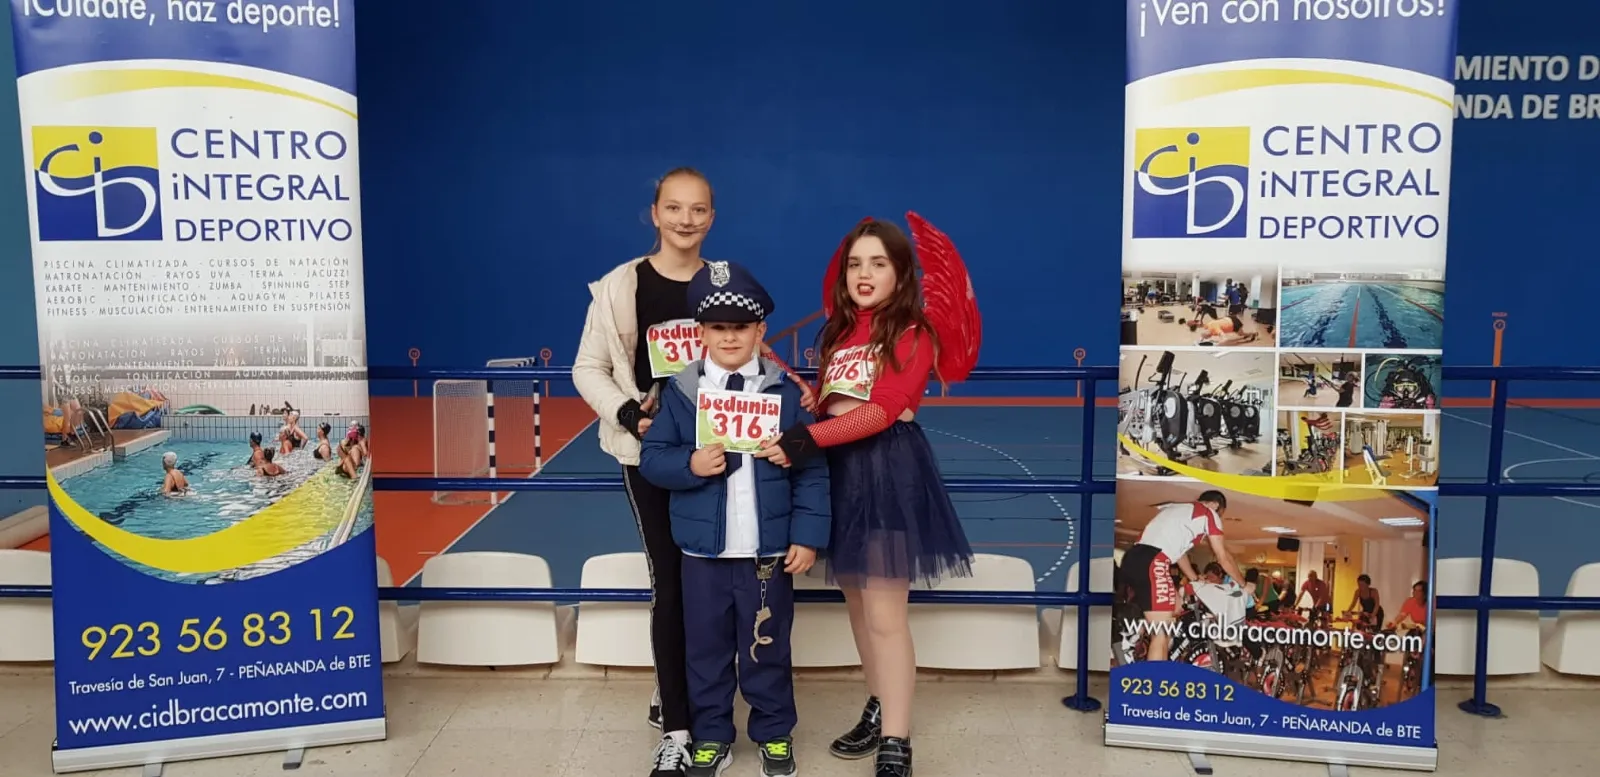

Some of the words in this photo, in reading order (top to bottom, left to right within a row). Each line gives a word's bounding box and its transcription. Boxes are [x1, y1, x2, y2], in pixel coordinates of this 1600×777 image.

[167, 0, 217, 22] haz
[226, 0, 340, 32] deporte!
[1140, 0, 1208, 37] ¡Ven
[1221, 0, 1279, 24] con
[1293, 0, 1445, 21] nosotros!
[1454, 55, 1570, 81] MIENTO
[1453, 94, 1514, 119] NDA
[1521, 94, 1560, 119] DE
[171, 128, 347, 160] CENTRO
[1263, 122, 1441, 156] CENTRO
[175, 219, 352, 241] DEPORTIVO
[1260, 214, 1439, 239] DEPORTIVO
[43, 260, 94, 269] PISCINA
[105, 259, 188, 268] CLIMATIZADA
[209, 258, 255, 267] CURSOS
[265, 258, 279, 267] DE
[289, 256, 349, 267] NATACIÓN
[45, 270, 142, 281] MATRONATACIÓN
[166, 271, 200, 280] RAYOS
[210, 270, 231, 279] UVA
[250, 269, 284, 278] TERMA
[306, 269, 349, 278] JACUZZI
[45, 284, 83, 293] KARATE
[103, 282, 189, 292] MANTENIMIENTO
[209, 281, 242, 290] ZUMBA
[262, 280, 310, 290] SPINNING
[329, 279, 350, 289] STEP
[46, 295, 96, 305] AEROBIC
[121, 292, 207, 304] TONIFICACIÓN
[231, 292, 286, 301] AQUAGYM
[309, 291, 350, 300] PILATES
[47, 307, 87, 317] FITNESS
[99, 304, 173, 316] MUSCULACIÓN
[184, 304, 268, 314] ENTRENAMIENTO
[273, 304, 285, 312] EN
[291, 301, 351, 312] SUSPENSIÓN
[170, 348, 204, 357] RAYOS
[699, 394, 779, 416] bedunia
[713, 413, 762, 439] 316
[1153, 559, 1169, 604] JOARA
[81, 621, 161, 661] 923
[177, 616, 228, 653] 56
[242, 611, 292, 647] 83
[310, 606, 355, 641] 12
[1124, 613, 1422, 653] www.cidbracamonte.com
[69, 677, 124, 695] Travesía
[128, 674, 145, 690] de
[149, 672, 174, 688] San
[177, 668, 212, 686] Juan,
[216, 667, 225, 682] 7
[238, 659, 326, 679] PEÑARANDA
[329, 656, 345, 671] de
[348, 654, 371, 669] BTE
[1121, 677, 1153, 696] 923
[1158, 680, 1180, 697] 56
[1185, 682, 1207, 699] 83
[1214, 684, 1234, 701] 12
[69, 690, 368, 735] www.cidbracamonte.com
[1121, 703, 1171, 721] Travesía
[1175, 706, 1191, 721] de
[1194, 709, 1218, 724] San
[1222, 711, 1256, 728] Juan,
[1259, 714, 1269, 727] 7
[1282, 713, 1372, 735] PEÑARANDA
[1376, 721, 1393, 737] de
[1397, 725, 1421, 739] BTE
